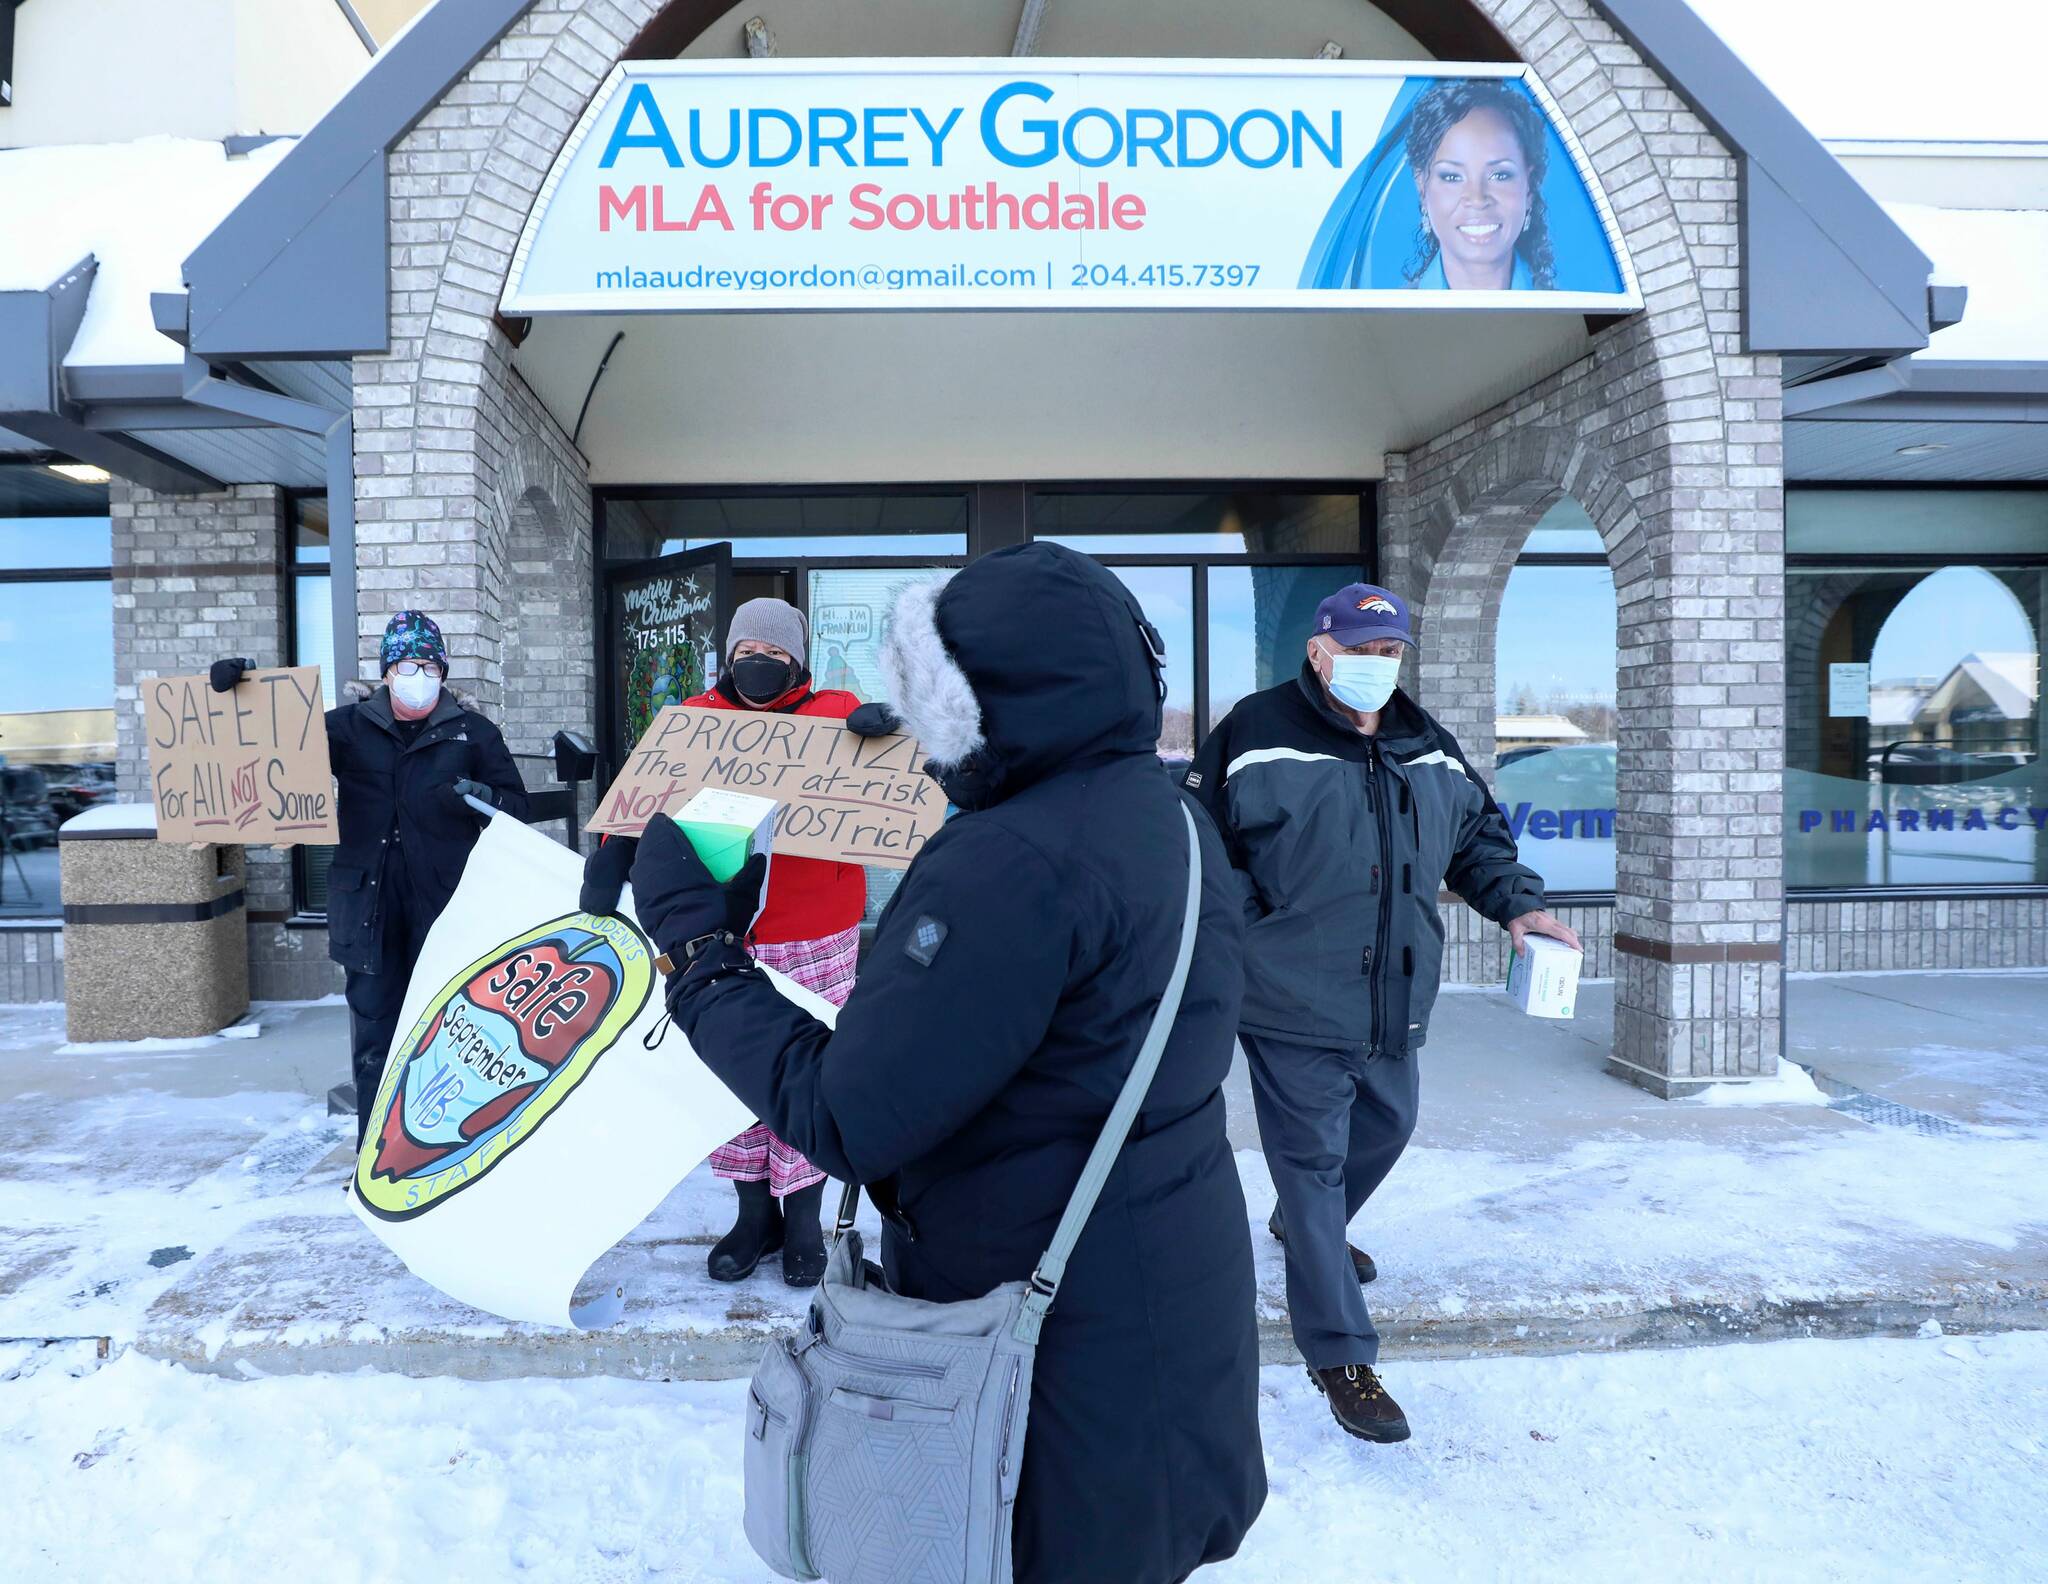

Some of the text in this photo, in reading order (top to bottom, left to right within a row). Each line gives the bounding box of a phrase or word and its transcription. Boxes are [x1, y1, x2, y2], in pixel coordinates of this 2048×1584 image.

[599, 81, 1342, 168] AUDREY GORDON
[599, 181, 1146, 233] MLA for Southdale
[596, 264, 1036, 290] mlaaudreygordon@gmail.com
[1071, 264, 1261, 287] 204.415.7397
[636, 624, 686, 650] 175-115
[820, 622, 868, 635] FRANKLIN
[155, 674, 319, 751] SAFETY
[157, 757, 329, 821] For All NOT Some
[633, 749, 932, 806] The MOST at-risk
[850, 817, 927, 850] rich
[1799, 808, 2048, 833] PHARMACY
[442, 1004, 527, 1088] September
[410, 1063, 464, 1130] MB
[404, 1115, 526, 1208] STAFF
